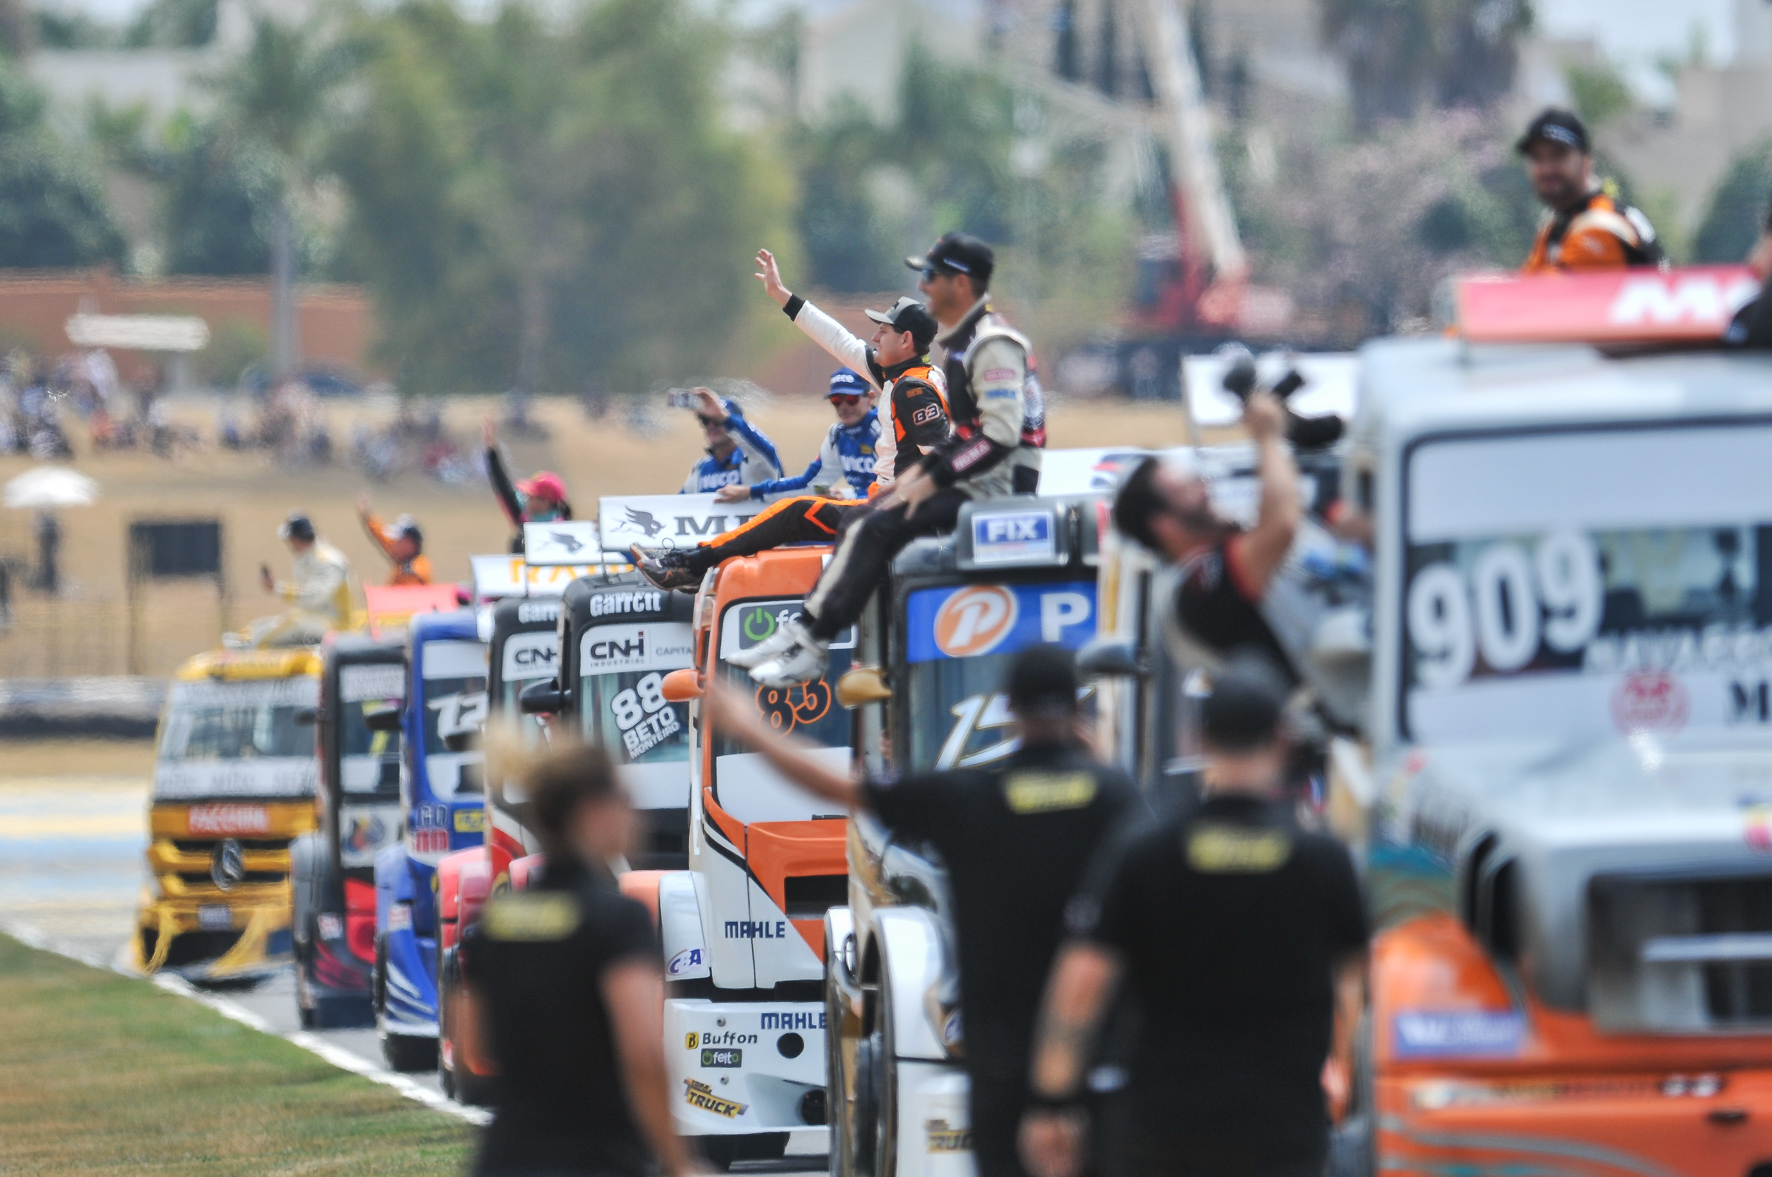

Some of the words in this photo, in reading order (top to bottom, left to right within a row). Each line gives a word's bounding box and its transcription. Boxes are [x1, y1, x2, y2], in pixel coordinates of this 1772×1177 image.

[988, 517, 1038, 541] FIX
[590, 591, 661, 617] Garrett
[1407, 528, 1604, 690] 909
[611, 672, 667, 731] 88
[623, 706, 676, 750] BETO
[629, 721, 682, 760] MONTEIRO
[724, 921, 786, 939] MAHLE
[760, 1012, 828, 1030] MAHLE
[702, 1031, 758, 1046] Buffon
[688, 1090, 737, 1118] TRUCK
